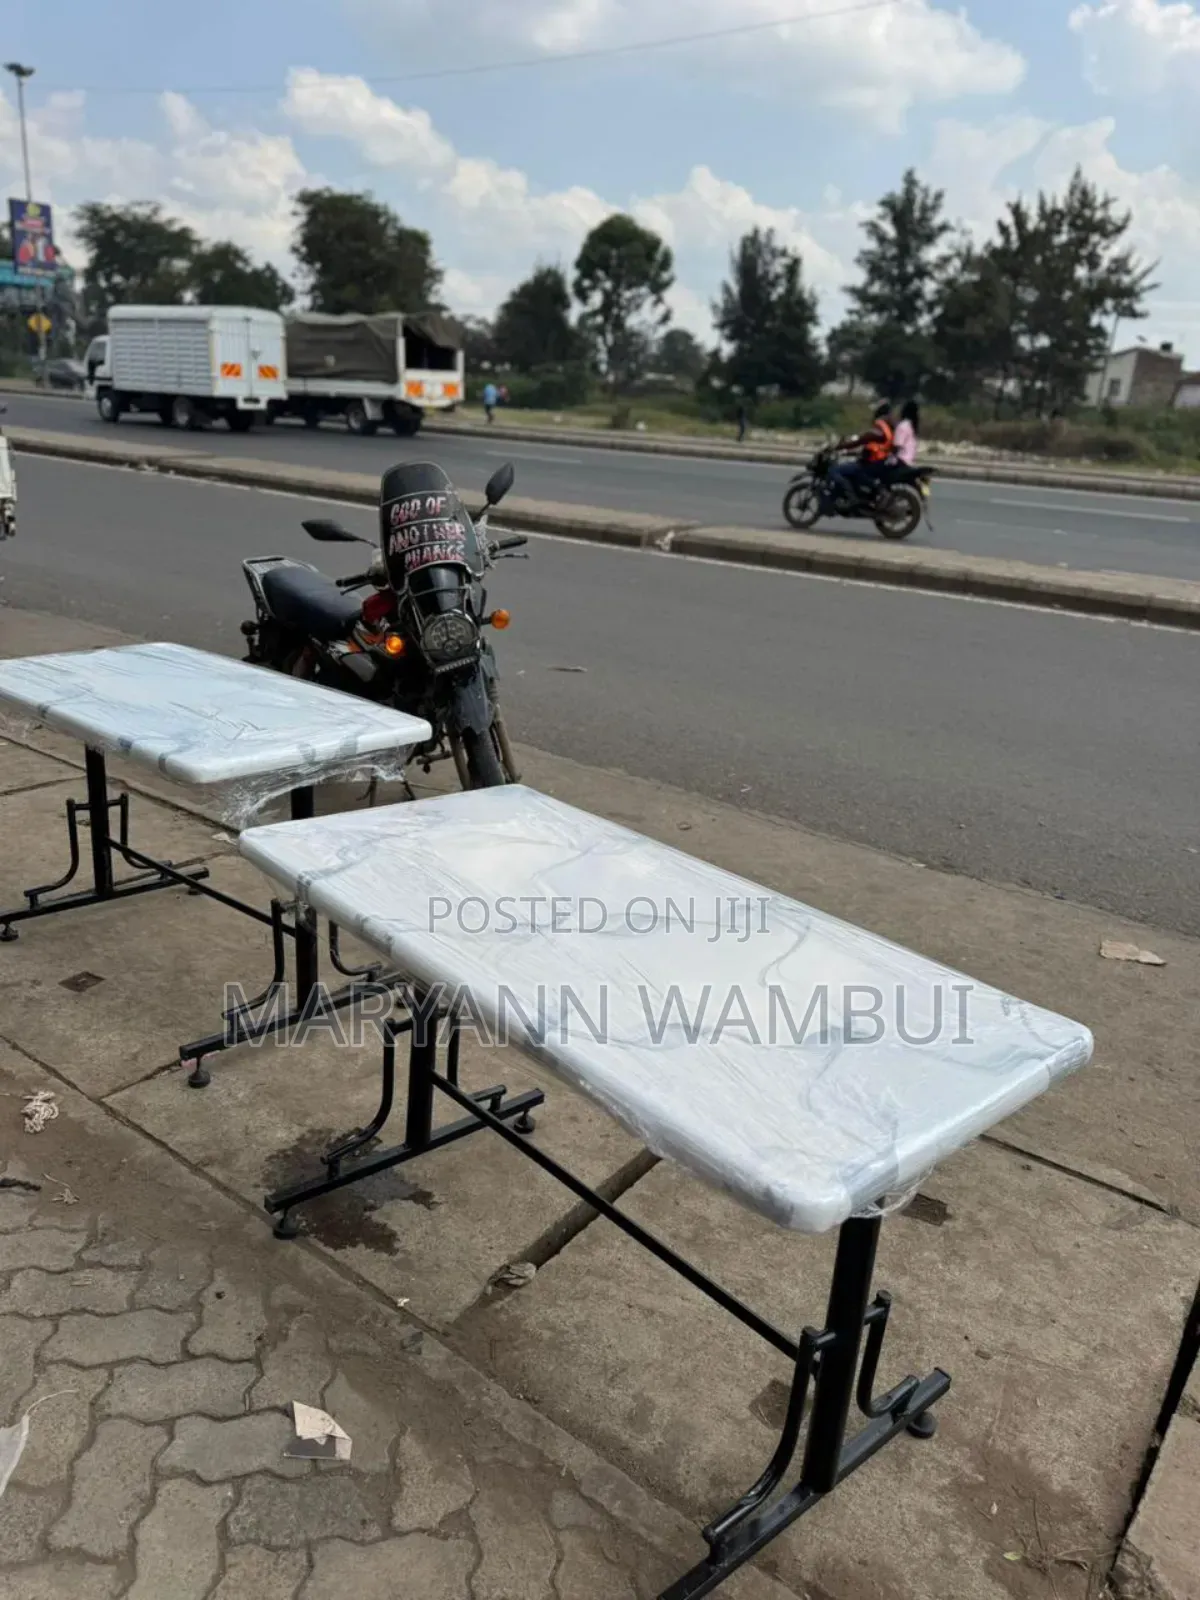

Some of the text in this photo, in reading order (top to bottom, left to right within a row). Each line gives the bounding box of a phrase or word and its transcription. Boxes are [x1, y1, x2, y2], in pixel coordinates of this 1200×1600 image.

[390, 496, 447, 525] GOD OF
[388, 522, 466, 556] ANOTHER
